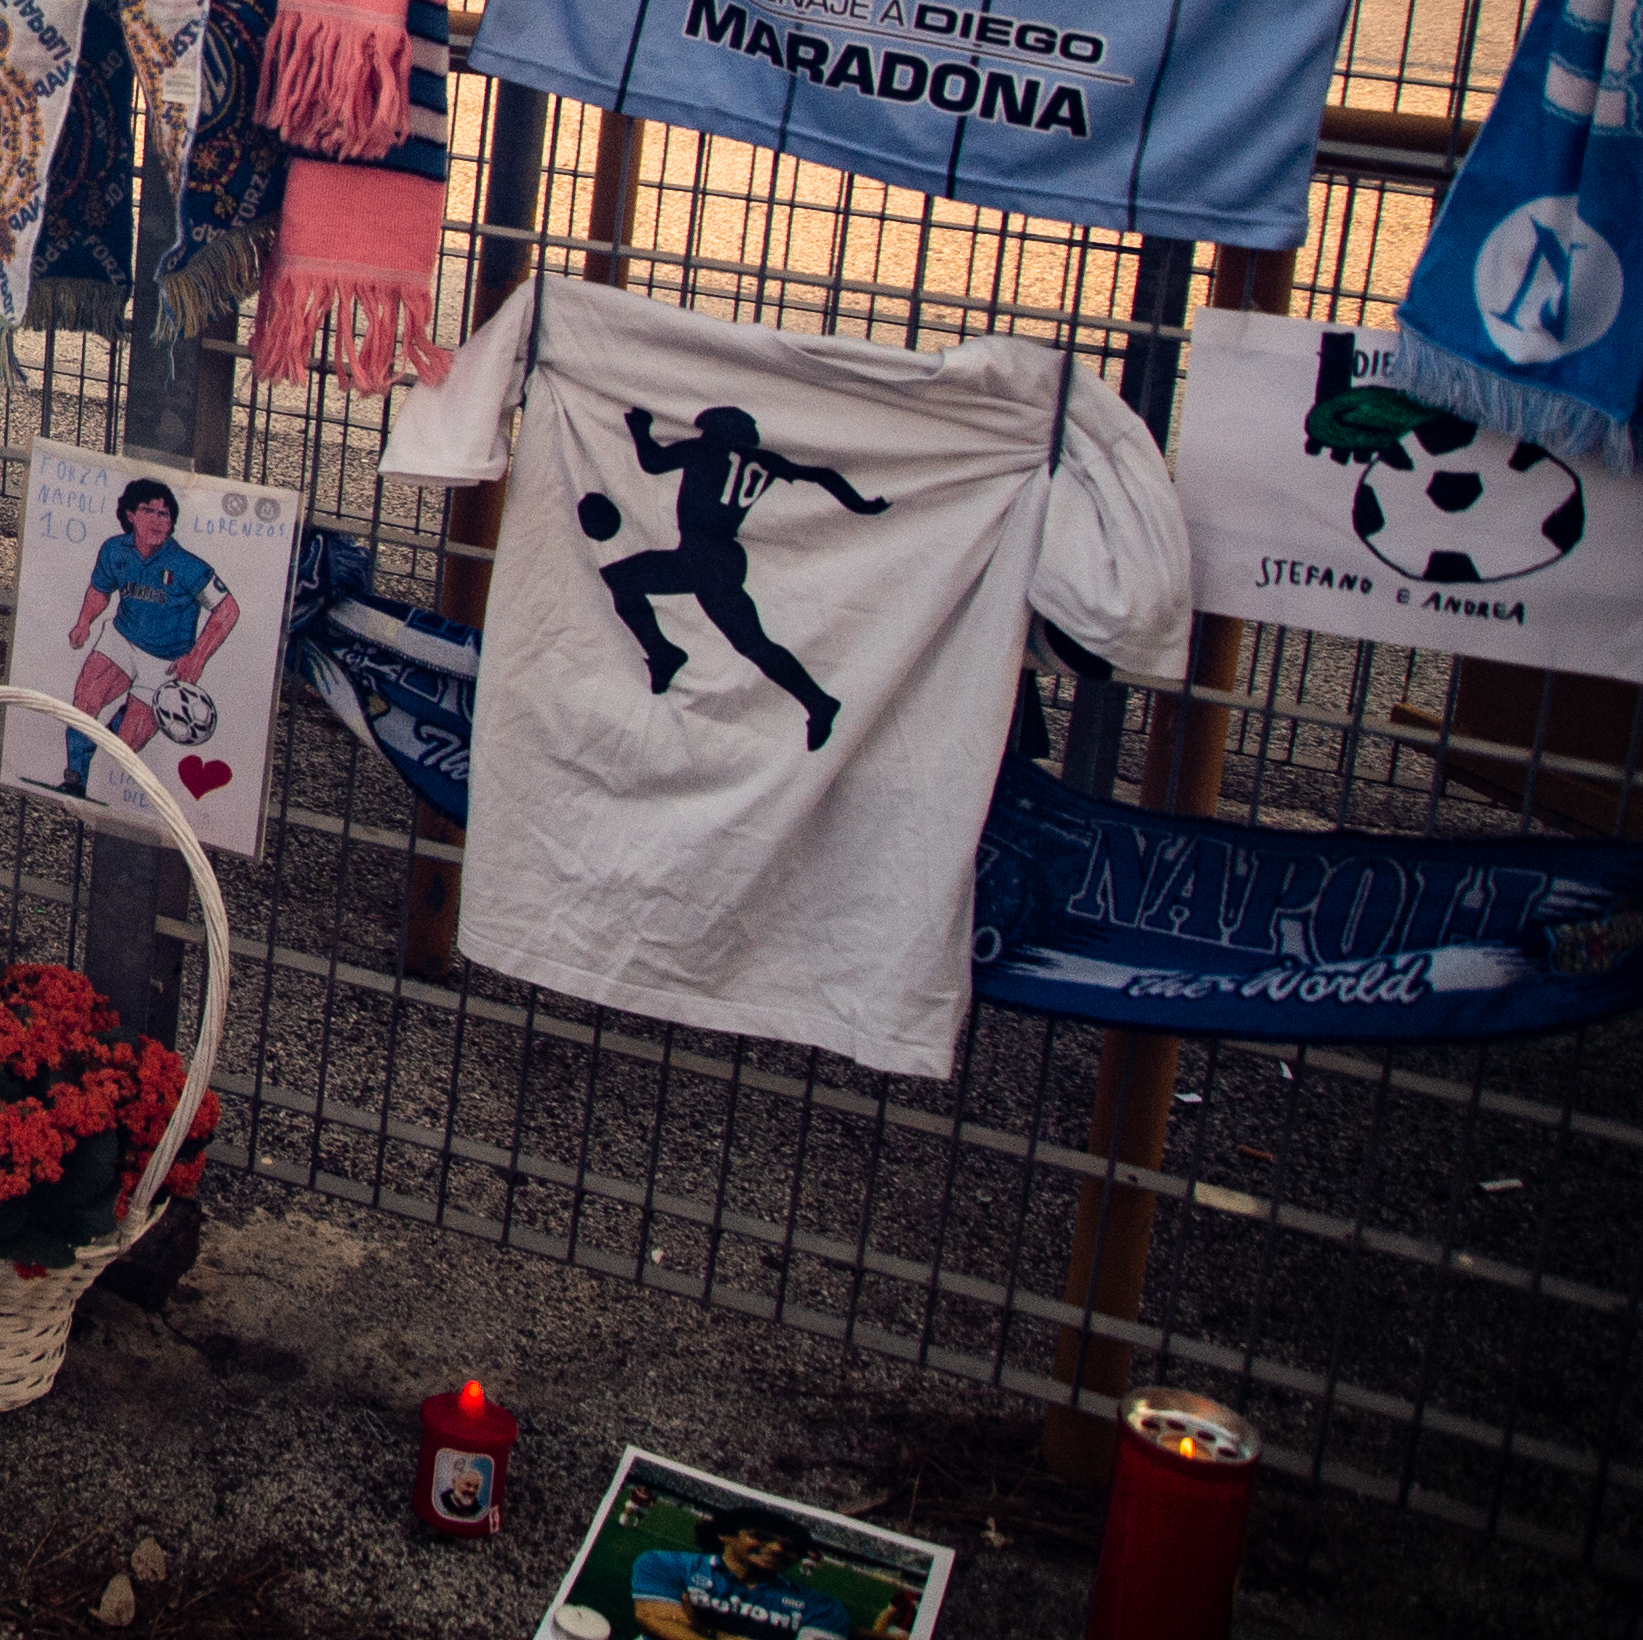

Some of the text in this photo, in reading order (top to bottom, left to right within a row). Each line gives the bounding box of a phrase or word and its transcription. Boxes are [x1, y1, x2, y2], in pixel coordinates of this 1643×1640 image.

[914, 0, 1106, 65] DIEGO
[38, 485, 107, 514] NAPOLI
[39, 457, 108, 487] FORZA
[719, 451, 769, 507] 10
[40, 511, 88, 544] 10
[1256, 557, 1373, 595] STEFANO
[1423, 590, 1525, 625] ANDREA
[1068, 819, 1549, 972] NAPOLI
